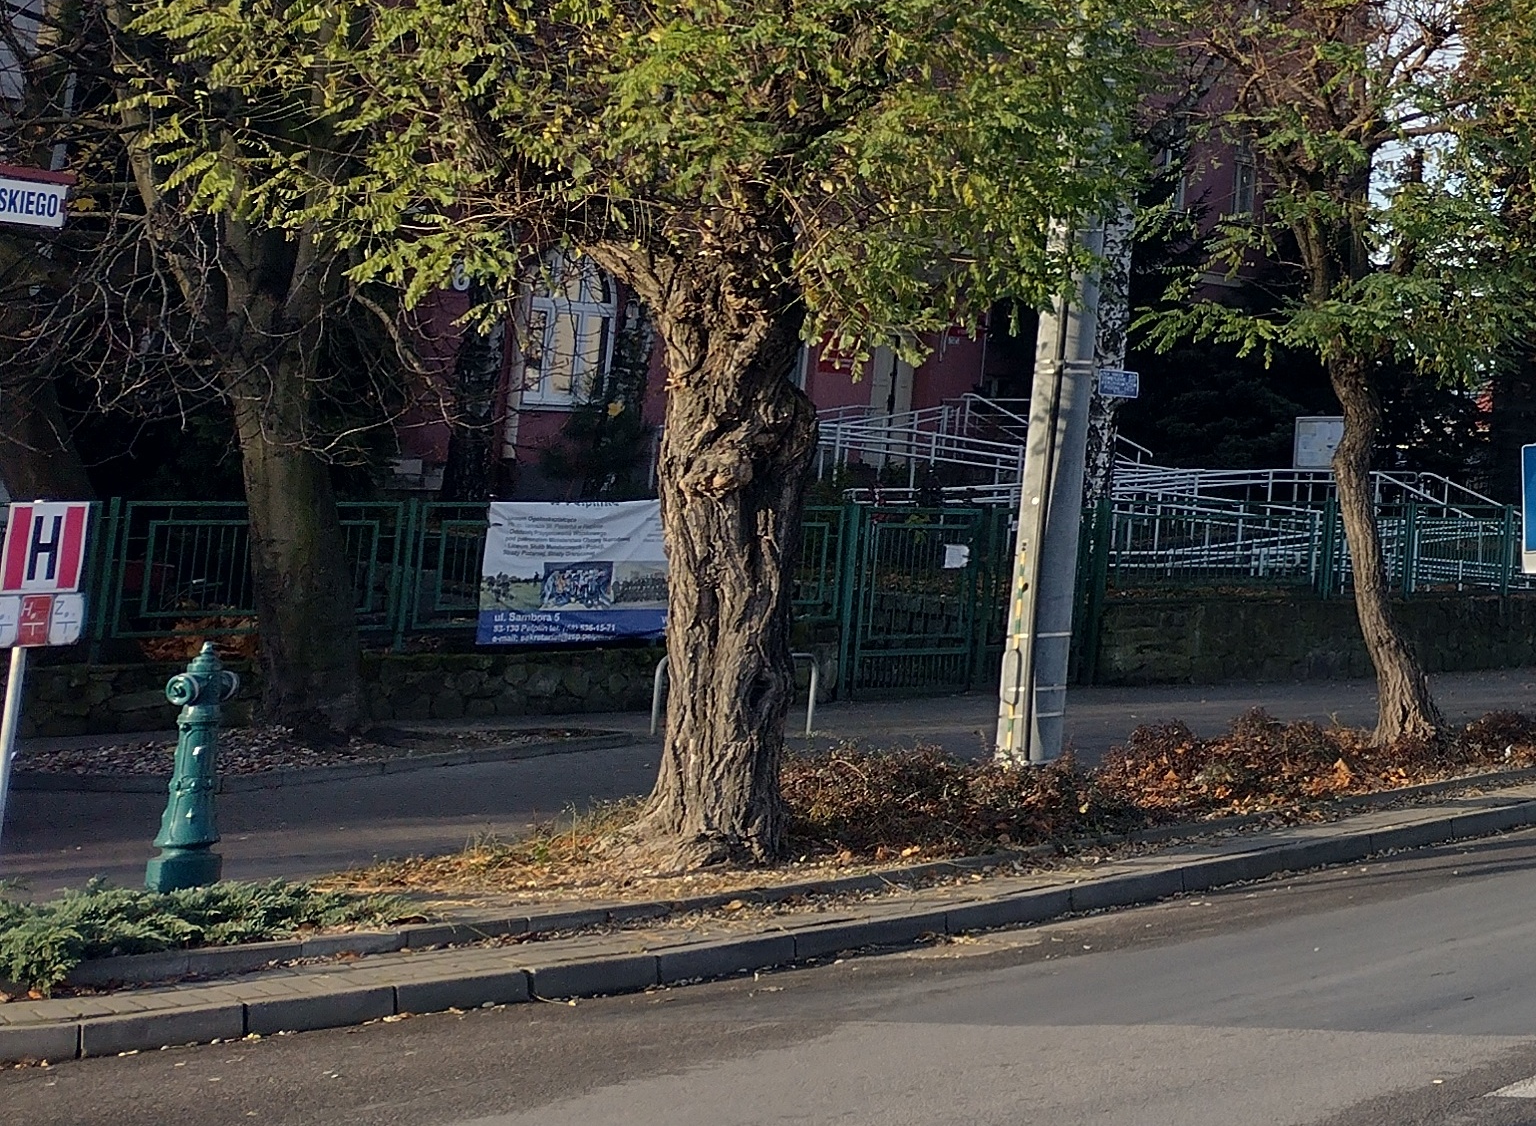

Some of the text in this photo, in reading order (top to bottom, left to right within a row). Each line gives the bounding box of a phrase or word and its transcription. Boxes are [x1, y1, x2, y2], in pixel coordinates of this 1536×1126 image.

[0, 187, 58, 217] SKIEGO
[26, 515, 63, 581] H
[494, 613, 506, 622] ul.
[509, 612, 552, 623] Sambora
